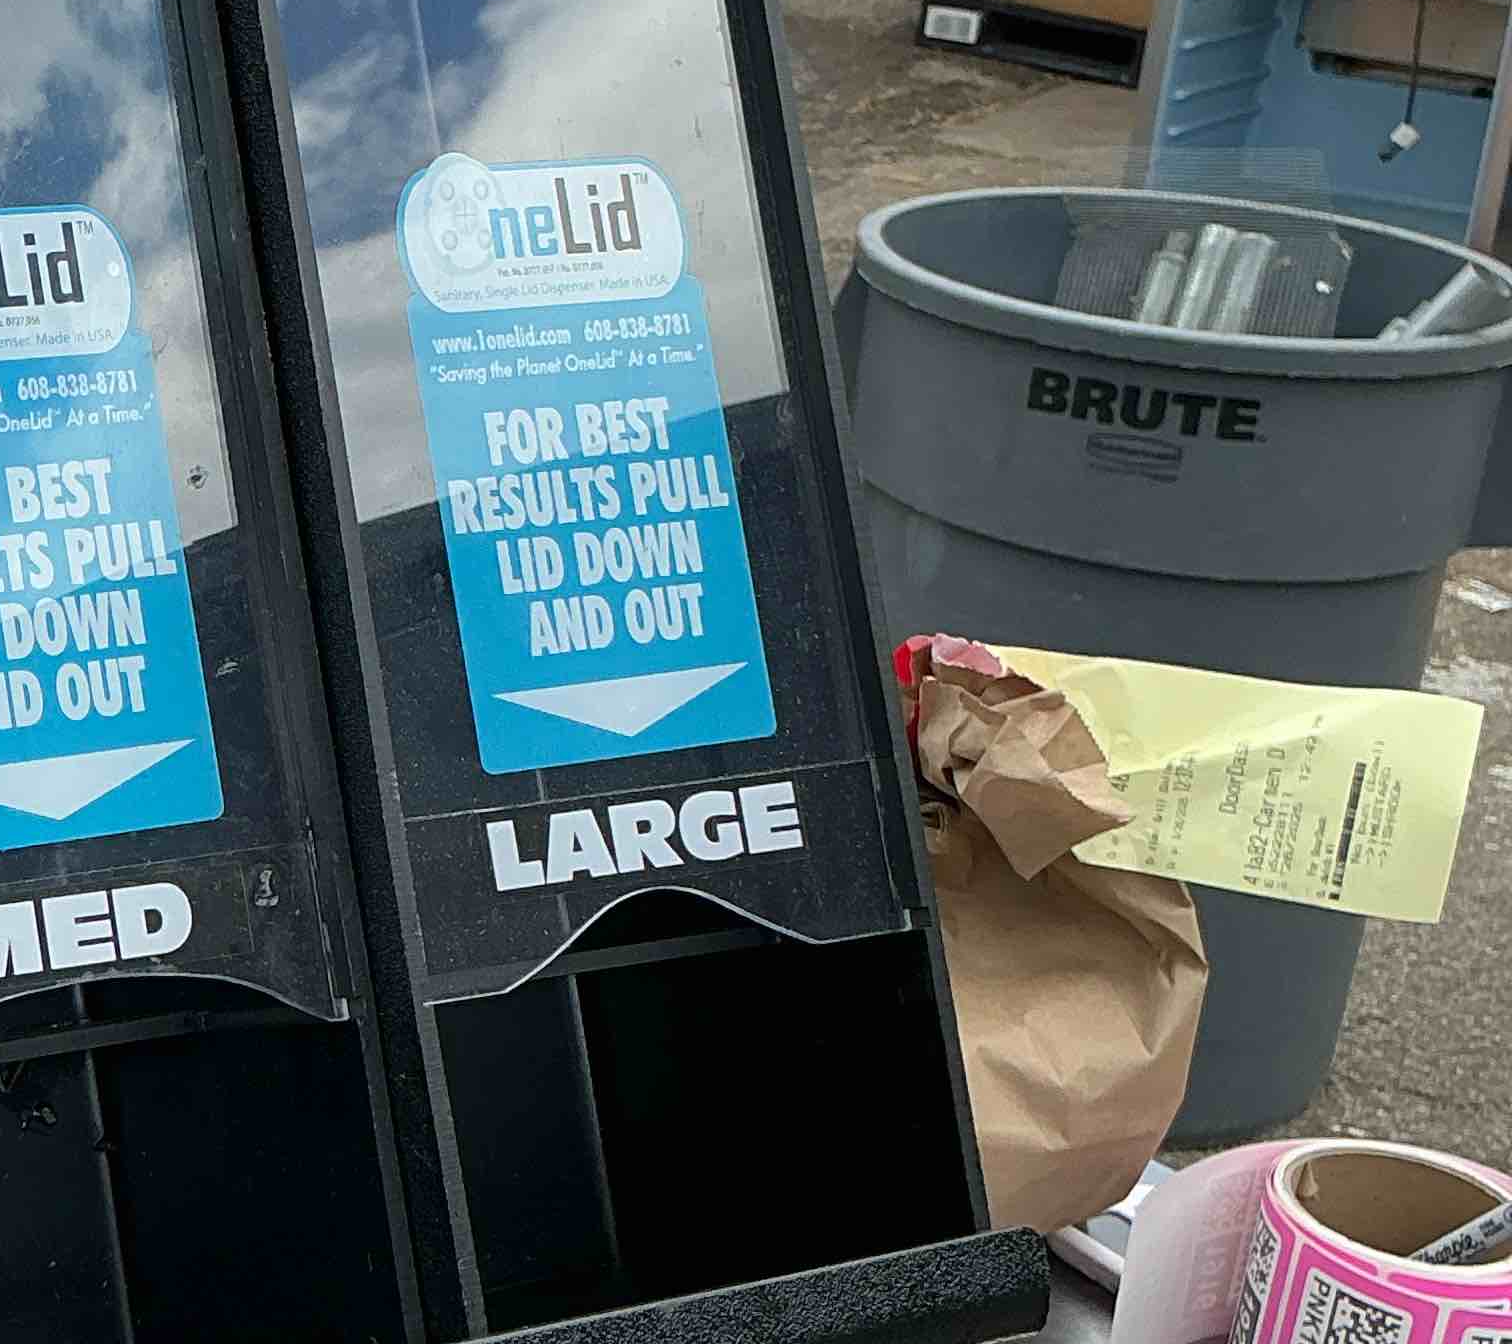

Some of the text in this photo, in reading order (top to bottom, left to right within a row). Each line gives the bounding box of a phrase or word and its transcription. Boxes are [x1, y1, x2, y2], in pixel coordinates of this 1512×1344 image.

[37, 328, 71, 346] Made
[431, 312, 691, 356] www.1onelid.com 608-838-8781
[490, 360, 513, 380] the
[516, 355, 561, 376] Planet
[627, 349, 644, 367] At
[646, 352, 657, 366] a
[17, 369, 138, 402] 608-838-8781
[65, 406, 87, 427] At
[88, 408, 100, 425] a
[1026, 367, 1263, 442] BRUTE
[483, 397, 672, 469] FOR BEST
[5, 458, 113, 525] BEST
[447, 453, 730, 536] RESULTS PULL
[63, 519, 178, 586] PULL
[495, 519, 704, 596] LID DOWN
[529, 584, 705, 657] AND OUT
[55, 656, 146, 723] OUT
[486, 780, 806, 893] LARGE
